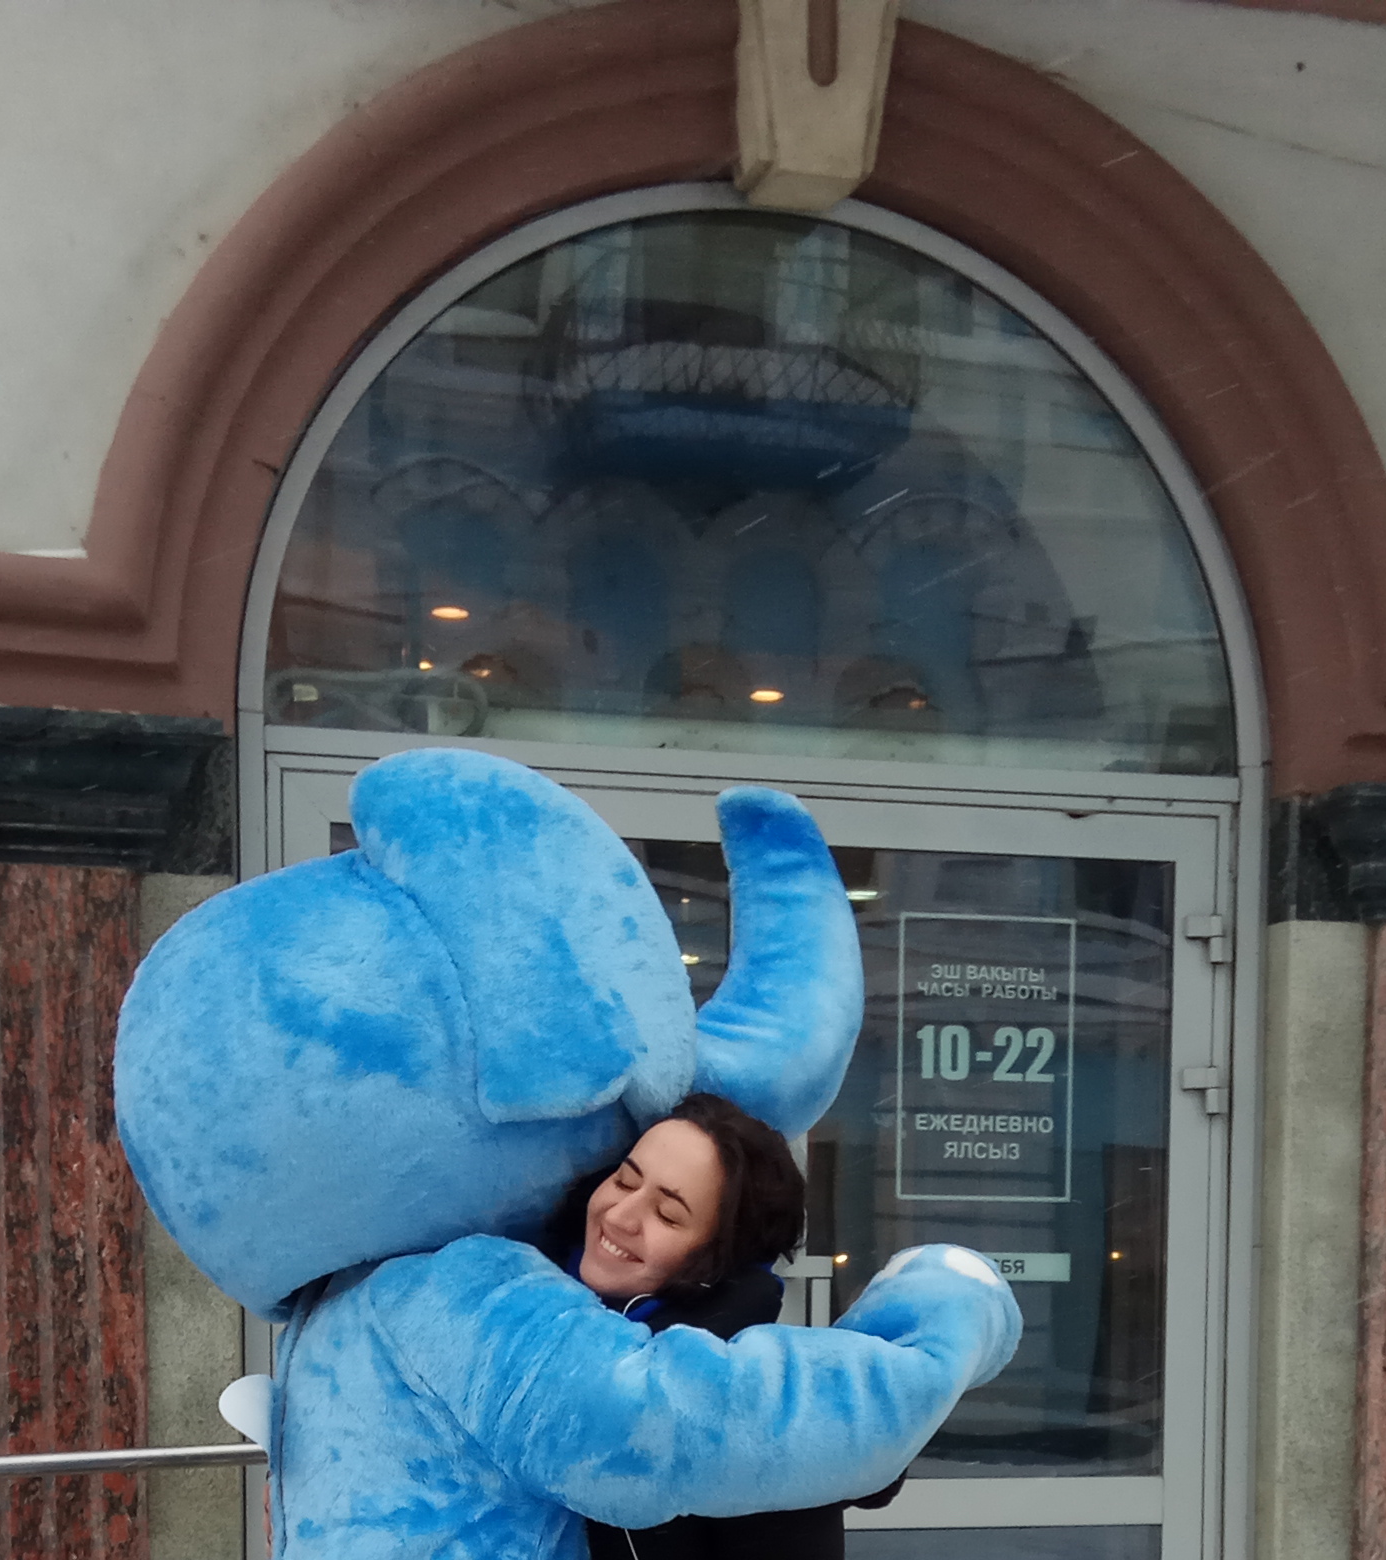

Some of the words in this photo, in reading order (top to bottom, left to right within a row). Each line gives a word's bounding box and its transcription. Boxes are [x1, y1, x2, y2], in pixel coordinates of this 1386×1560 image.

[931, 963, 962, 980] ЭШ
[966, 965, 1046, 983] ВАКЫТЫ
[917, 981, 971, 998] ЧАСЫ
[981, 983, 1059, 1001] РАБОТЫ
[916, 1024, 1056, 1083] 10-22
[914, 1112, 1055, 1136] ЕЖЕДНЕВНО
[943, 1140, 1021, 1160] ЯЛСЫЗ
